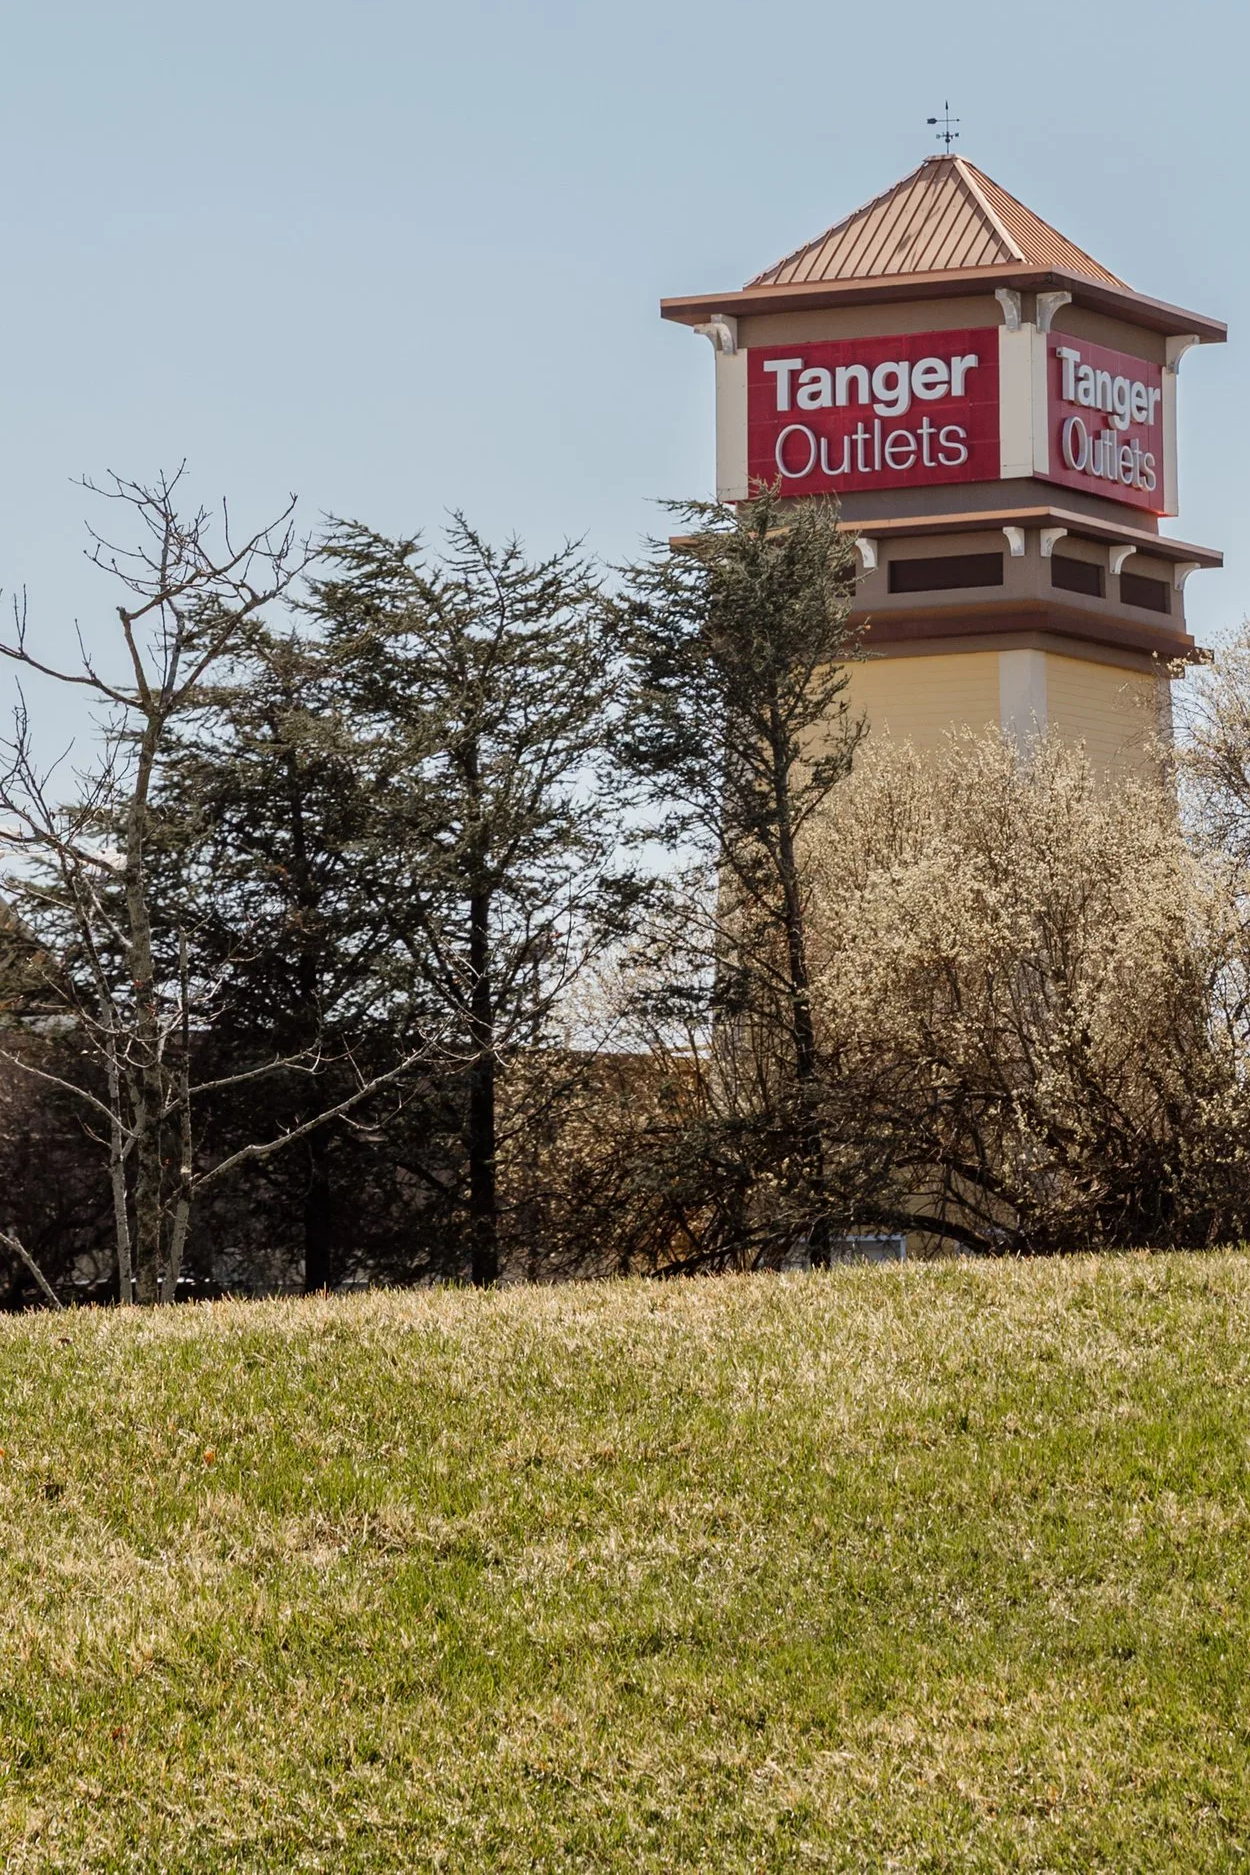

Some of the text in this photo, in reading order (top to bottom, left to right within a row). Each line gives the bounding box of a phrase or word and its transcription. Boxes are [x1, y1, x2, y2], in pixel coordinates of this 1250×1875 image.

[763, 354, 978, 416] Tanger
[1057, 346, 1161, 430] Tanger
[775, 417, 968, 478] Outlets
[1063, 416, 1156, 492] Outlets
